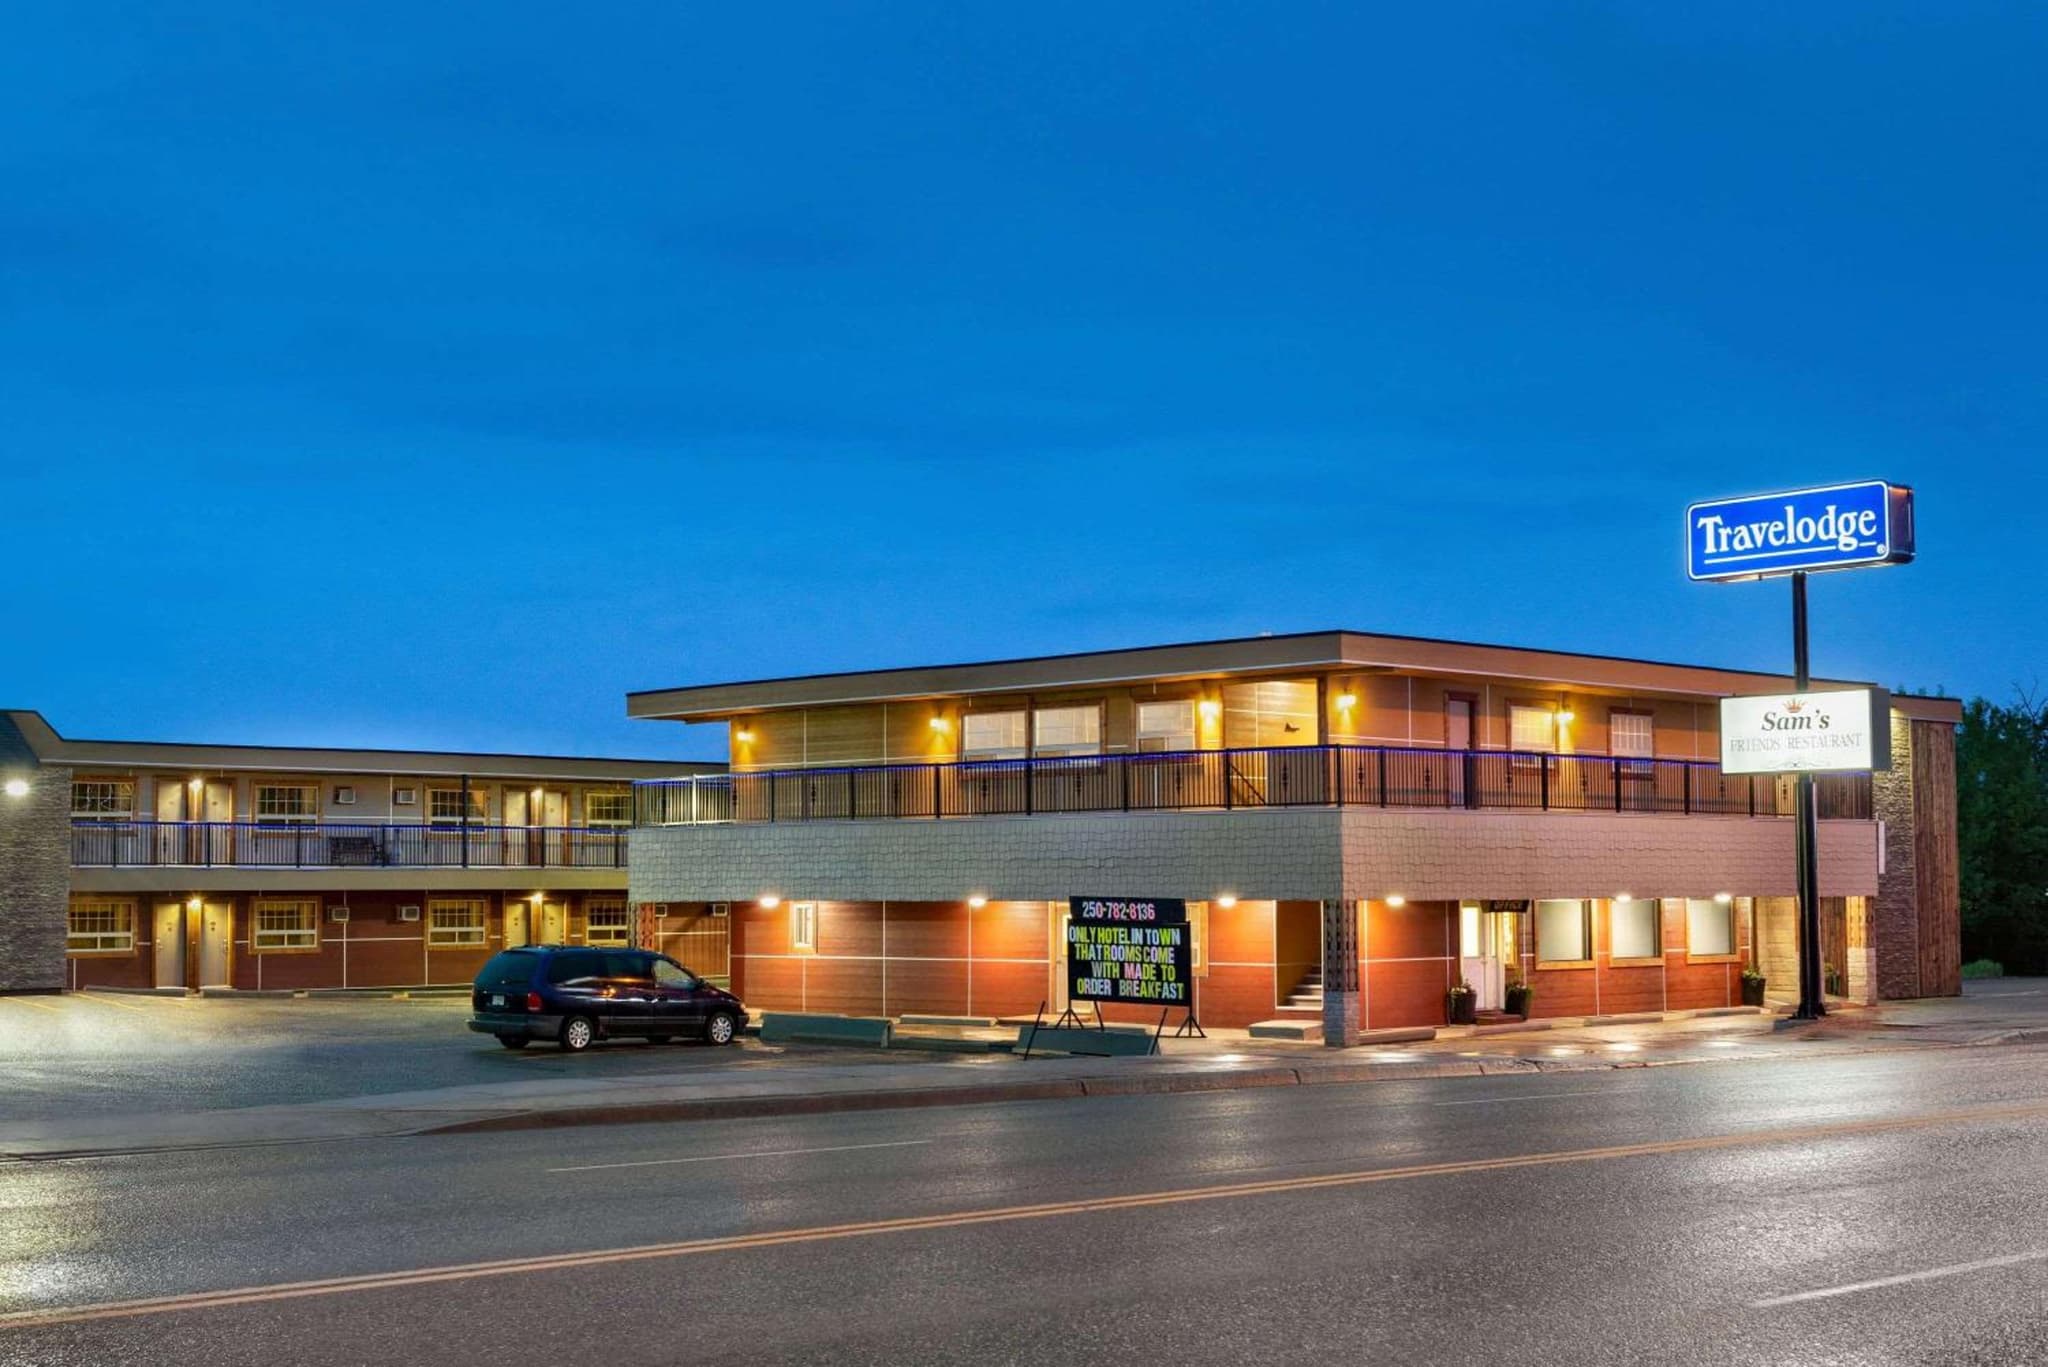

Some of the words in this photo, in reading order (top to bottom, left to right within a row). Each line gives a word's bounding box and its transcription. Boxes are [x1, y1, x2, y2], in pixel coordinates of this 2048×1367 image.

[1697, 505, 1877, 553] Travelodge
[1761, 709, 1830, 731] Sam's
[1787, 733, 1862, 749] RESTAURANT
[1082, 902, 1155, 920] 250-782-8136
[1069, 926, 1096, 943] ONLY
[1098, 927, 1130, 944] HOTEL
[1131, 928, 1143, 945] IN
[1145, 928, 1181, 945] TOWN
[1074, 943, 1102, 961] THAT
[1104, 945, 1142, 962] ROOMS
[1143, 947, 1175, 963] COME
[1091, 961, 1120, 978] WITH
[1124, 963, 1157, 980] MADE
[1161, 964, 1176, 981] TO
[1077, 978, 1112, 995] ORDER
[1119, 982, 1184, 999] BREAKFAST
